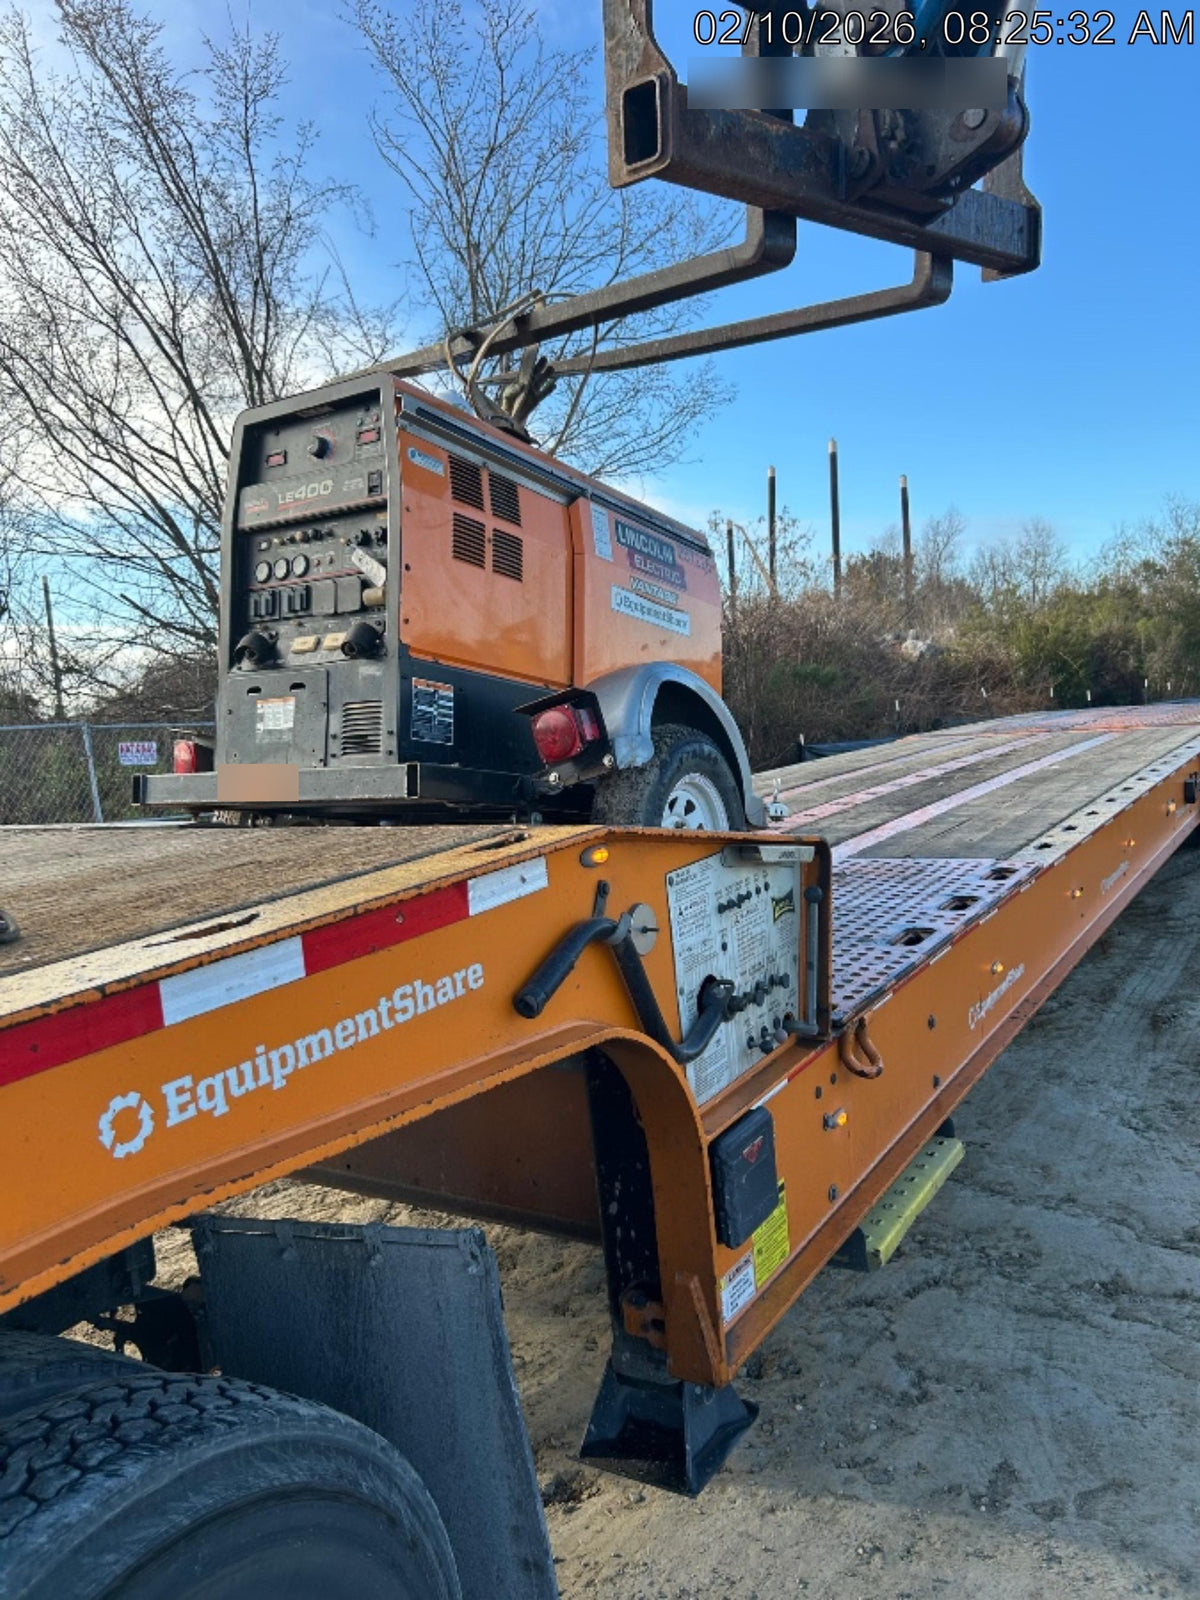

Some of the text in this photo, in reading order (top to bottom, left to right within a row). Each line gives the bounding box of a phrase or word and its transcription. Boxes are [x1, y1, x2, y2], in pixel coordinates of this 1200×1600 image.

[618, 524, 673, 564] LINCOLN
[634, 554, 682, 584] ELECTRIC
[161, 962, 484, 1128] EquipmentShare
